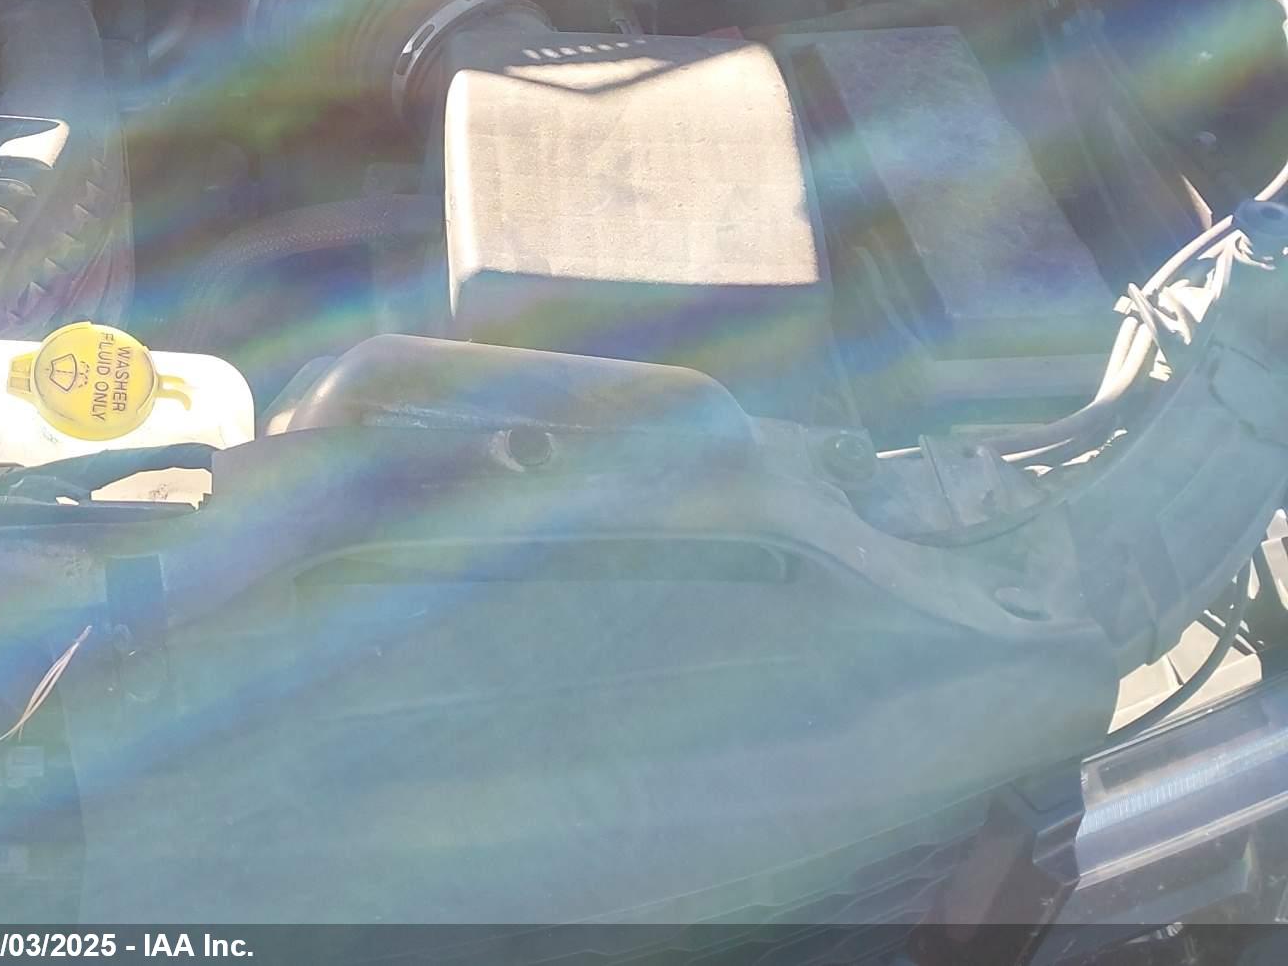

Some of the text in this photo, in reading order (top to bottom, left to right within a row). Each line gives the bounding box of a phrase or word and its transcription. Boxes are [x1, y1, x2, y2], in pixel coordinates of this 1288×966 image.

[92, 332, 114, 421] FLUID ONLY
[112, 346, 131, 412] WASHER
